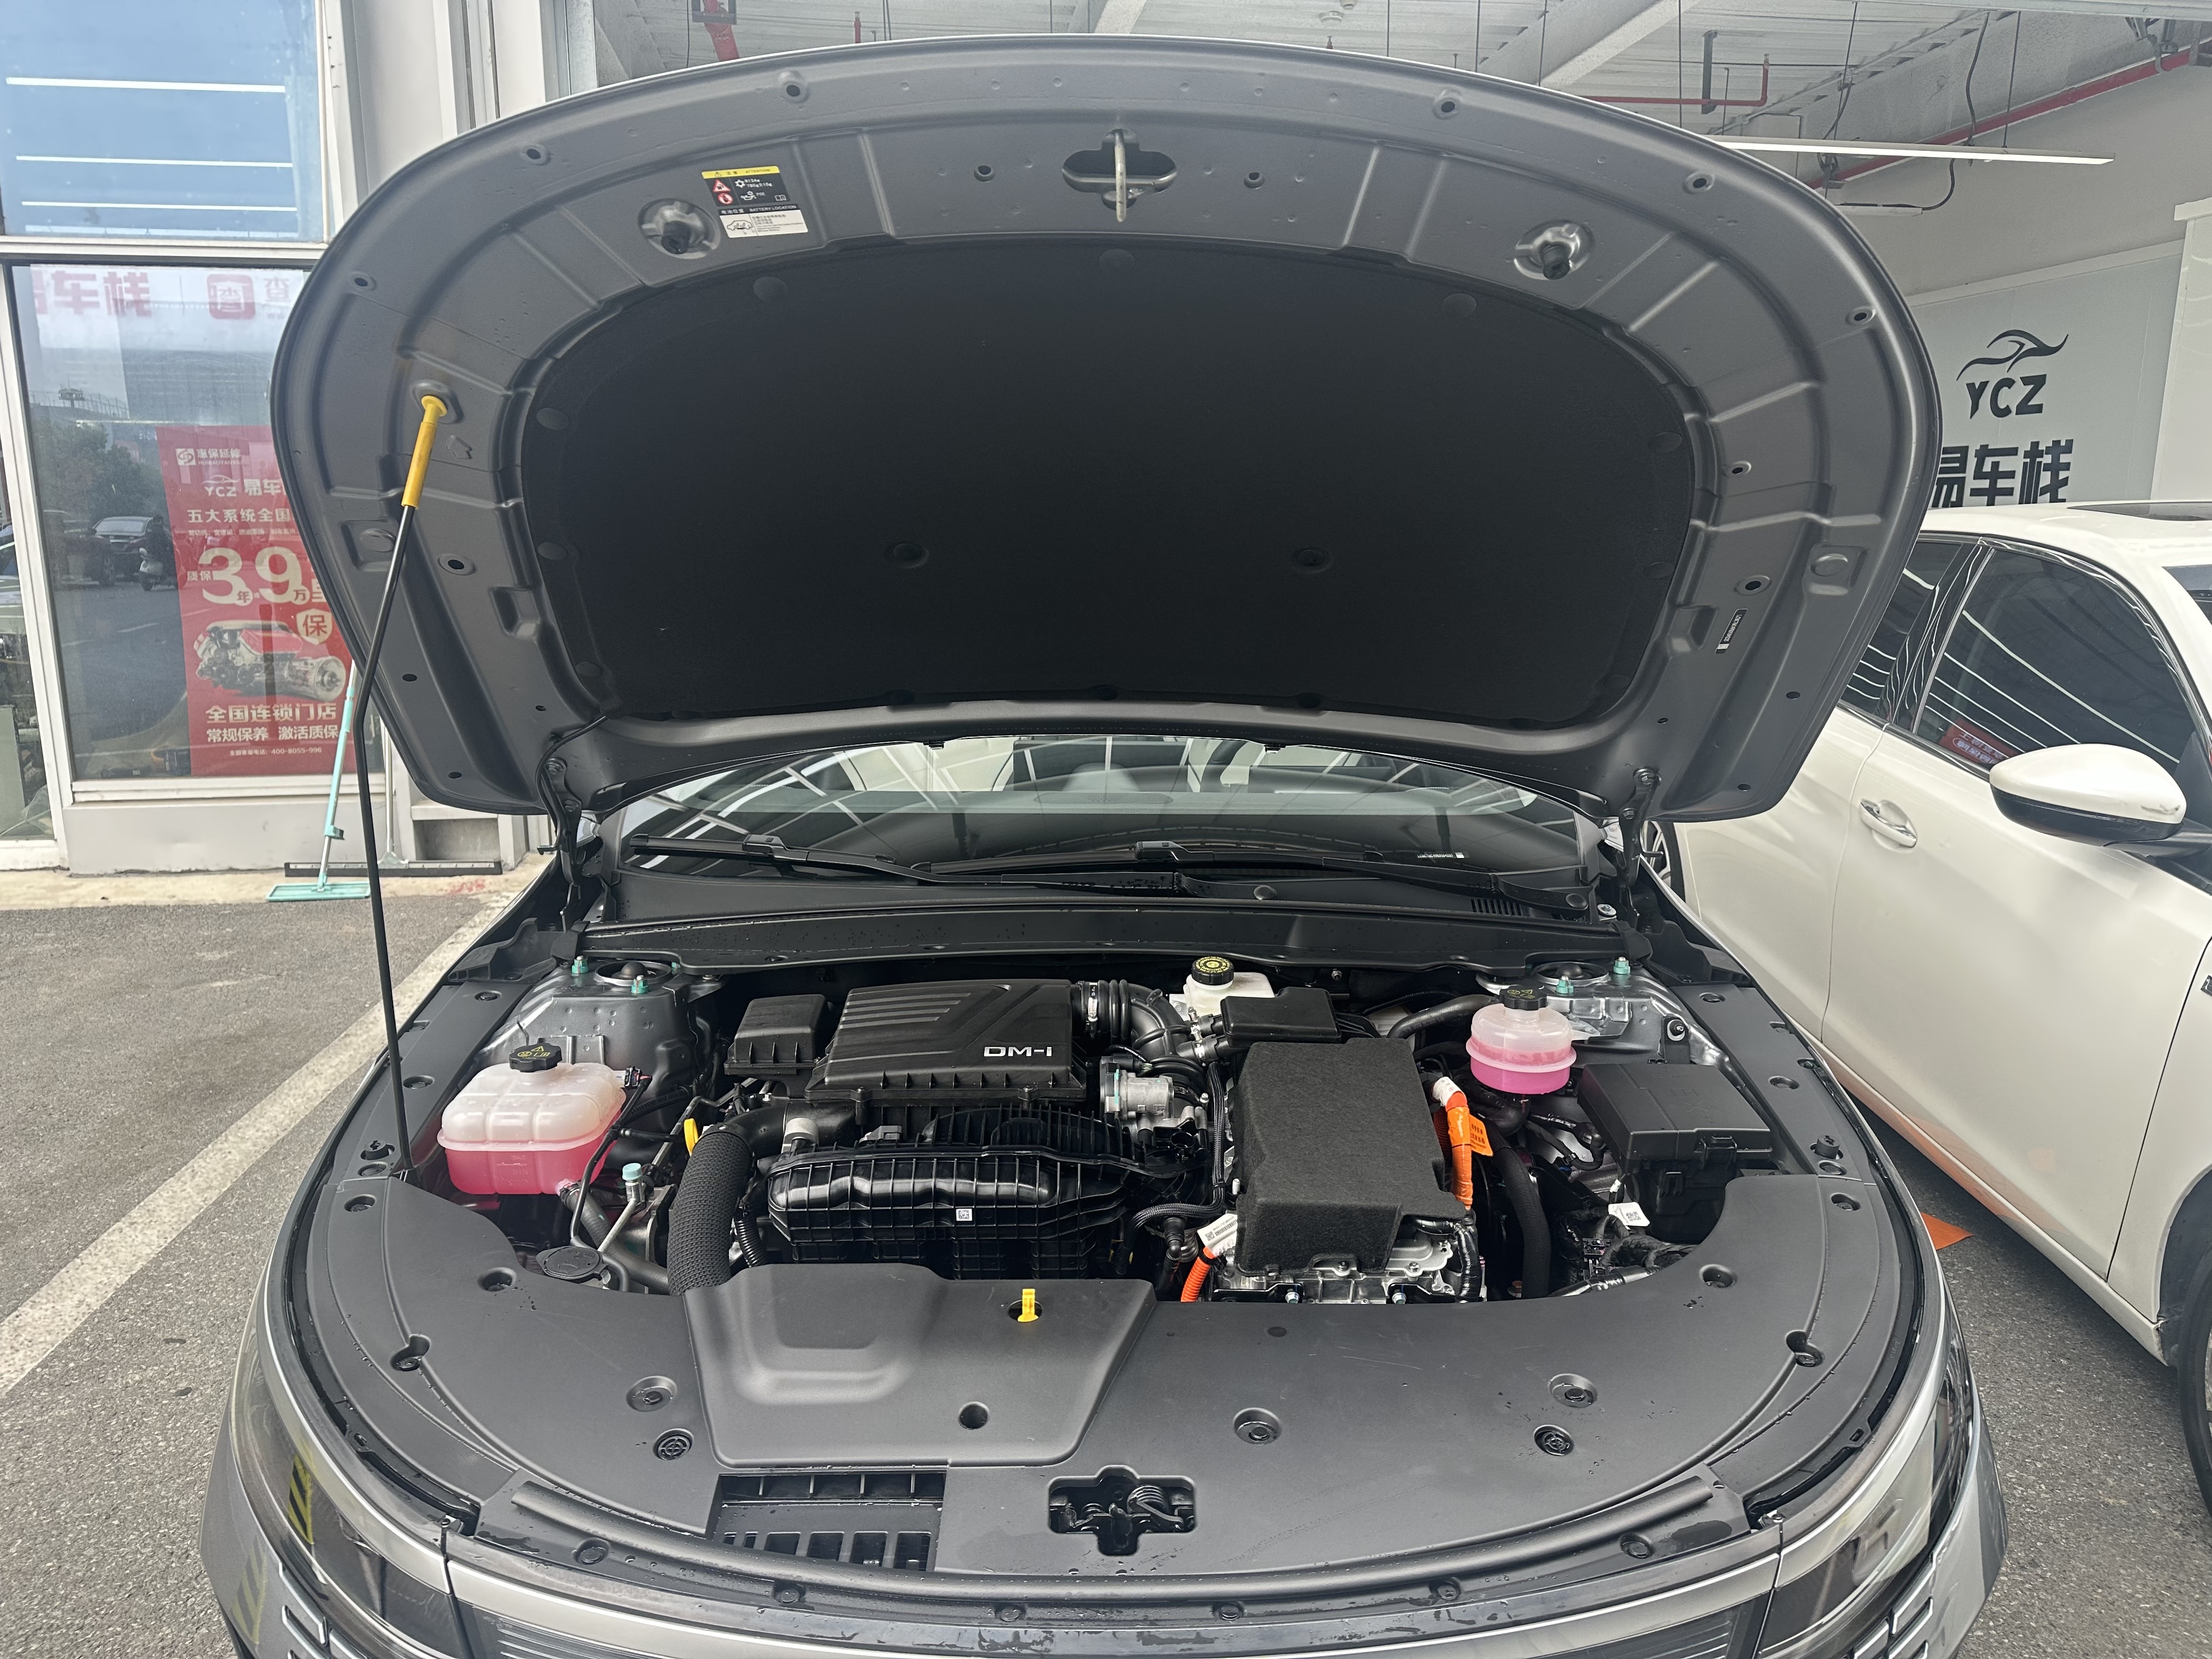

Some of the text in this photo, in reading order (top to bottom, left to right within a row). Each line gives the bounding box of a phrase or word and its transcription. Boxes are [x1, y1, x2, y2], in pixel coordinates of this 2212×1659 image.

[1966, 374, 2047, 419] YCZ
[204, 478, 286, 497] YCZ 易车
[303, 614, 328, 637] 保
[205, 702, 337, 724] 全国连锁门店
[206, 724, 339, 743] 常规保养 激活质保
